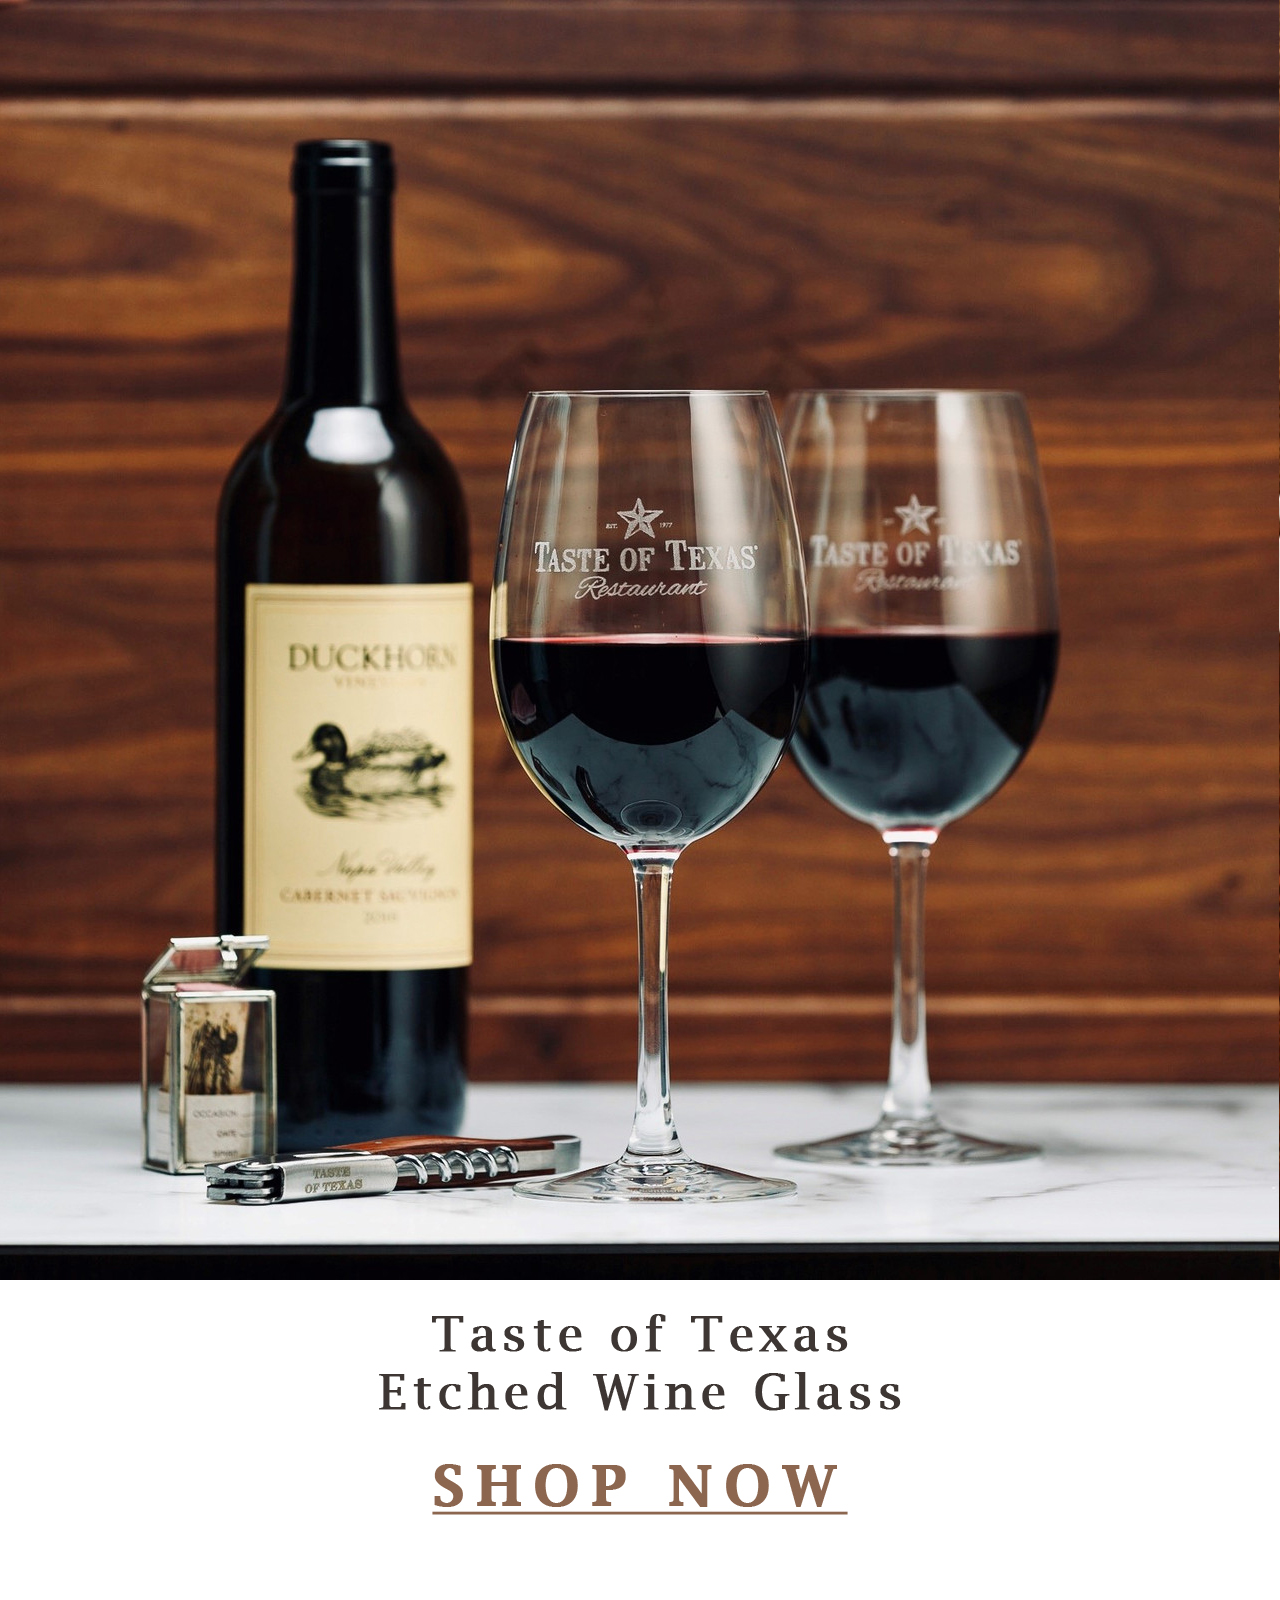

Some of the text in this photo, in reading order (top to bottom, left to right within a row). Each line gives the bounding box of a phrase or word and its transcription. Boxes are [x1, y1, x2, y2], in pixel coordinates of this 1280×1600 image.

[534, 541, 610, 573] TASTE
[619, 547, 656, 572] OF
[809, 534, 889, 567] TASTE
[896, 541, 921, 567] OF
[574, 575, 708, 601] Restaurant
[287, 642, 458, 673] DUCKHORN
[304, 1178, 364, 1194] OF TEXAS
[312, 1166, 352, 1179] TASTE
